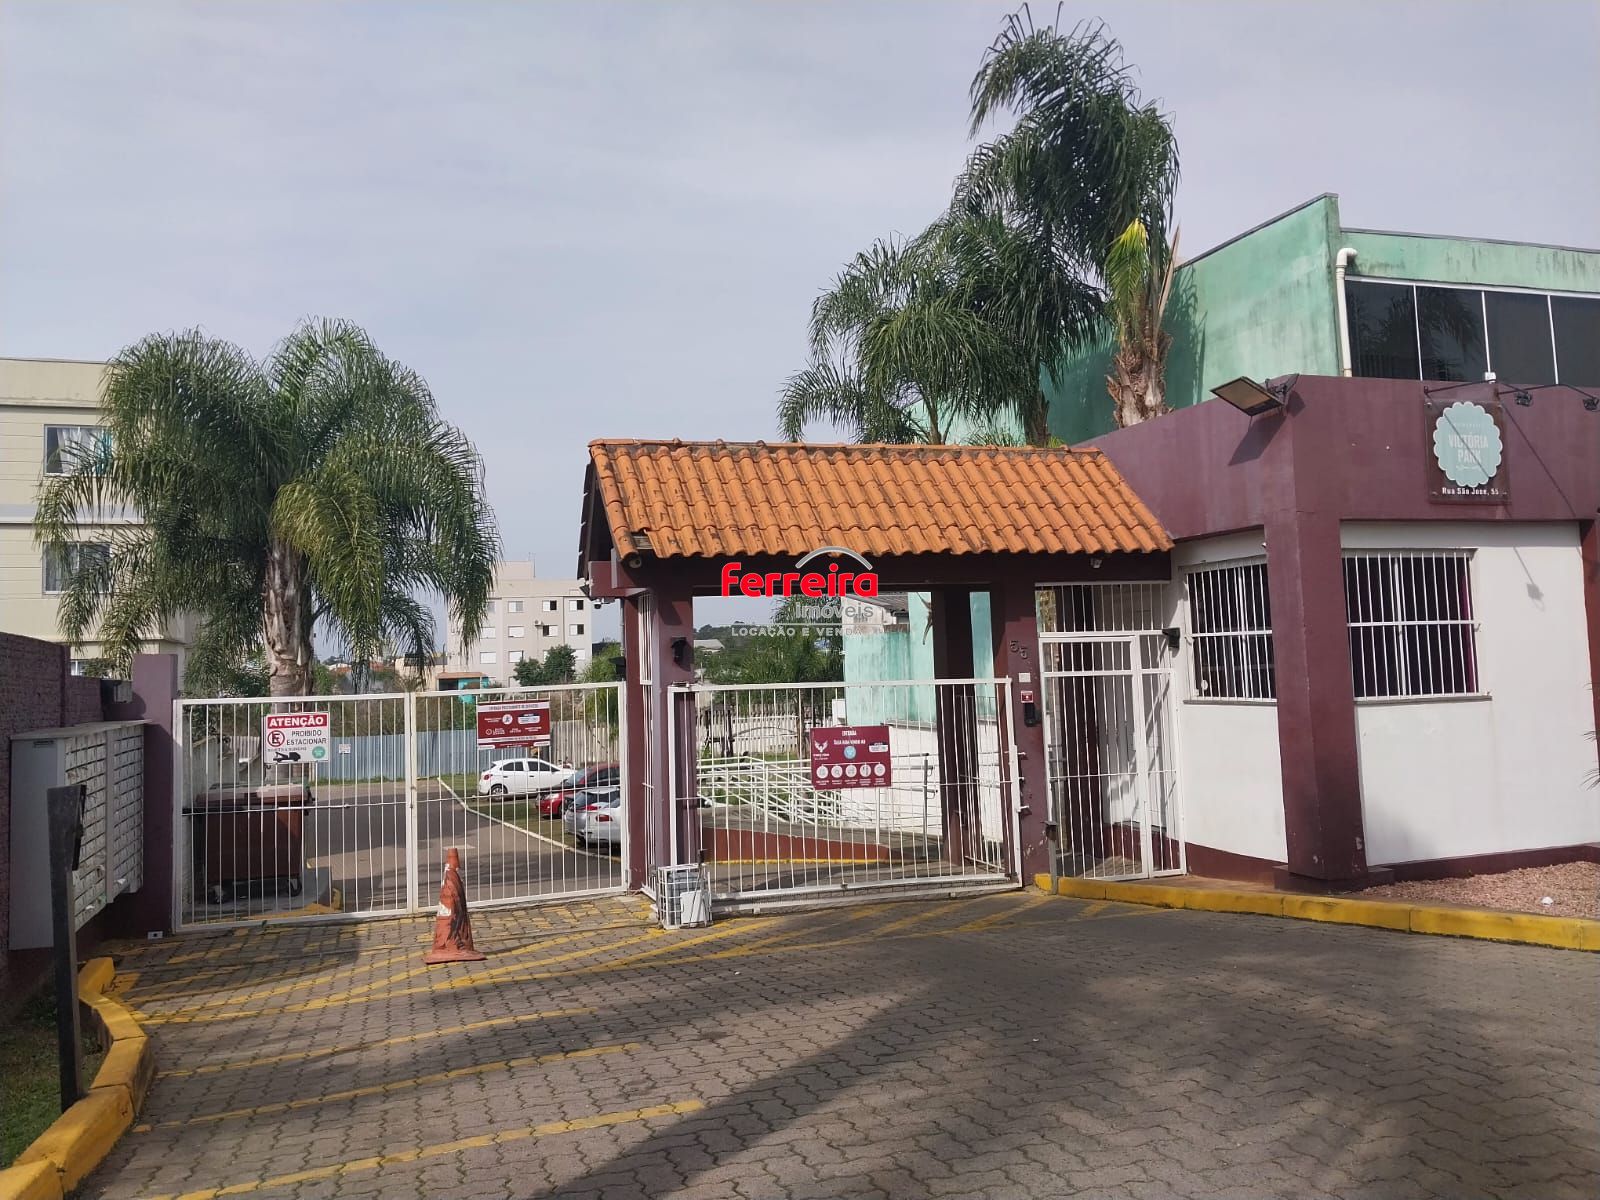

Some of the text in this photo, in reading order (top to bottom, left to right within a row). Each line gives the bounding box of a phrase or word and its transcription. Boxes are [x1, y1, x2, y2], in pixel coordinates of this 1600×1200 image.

[1457, 450, 1481, 464] PARK
[1442, 487, 1455, 495] Rua
[269, 716, 324, 727] ATENÇÃO
[291, 729, 322, 737] PROIBIDO
[286, 737, 327, 746] ESTACIONAR
